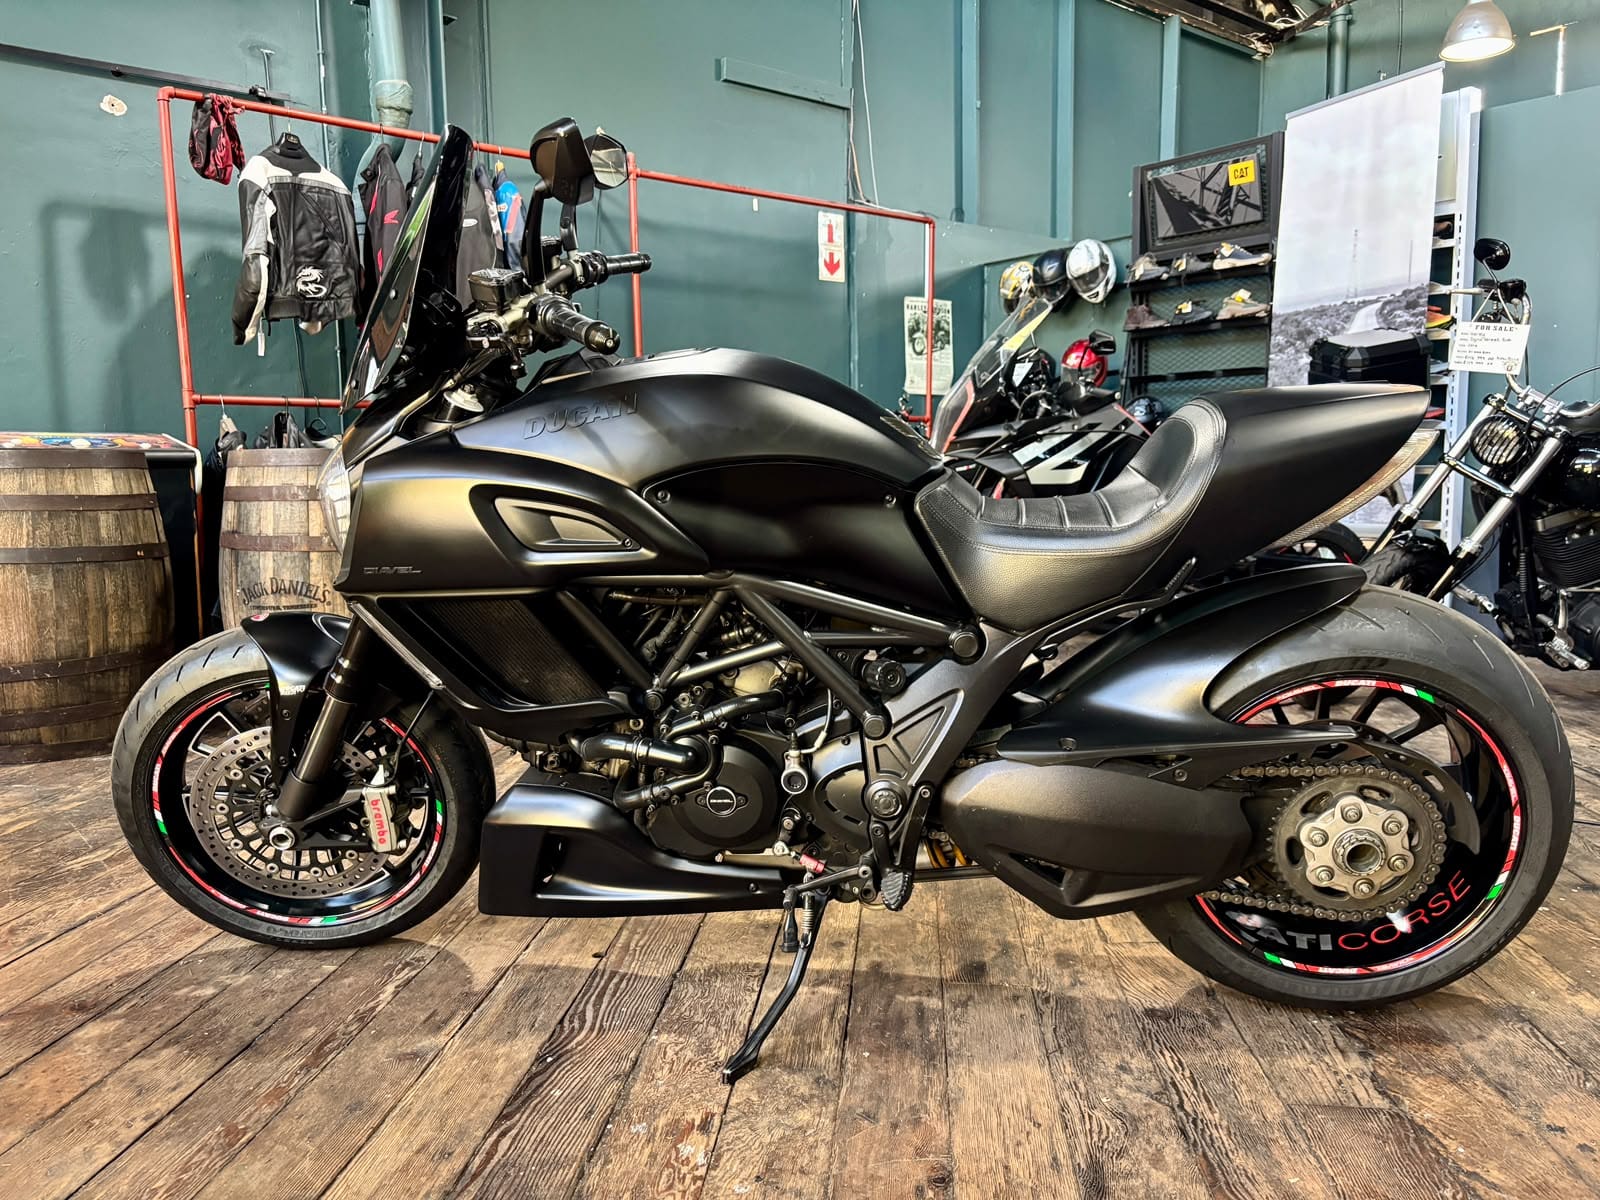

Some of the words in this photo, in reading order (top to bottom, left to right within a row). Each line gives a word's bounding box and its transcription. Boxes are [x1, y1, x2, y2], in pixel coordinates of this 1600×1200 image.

[1233, 166, 1249, 180] CAT
[523, 392, 638, 440] DUCATI
[241, 582, 268, 606] JACK
[270, 577, 330, 604] DANIEL'S
[1335, 679, 1377, 687] DUCATI
[1337, 869, 1471, 951] CORSE
